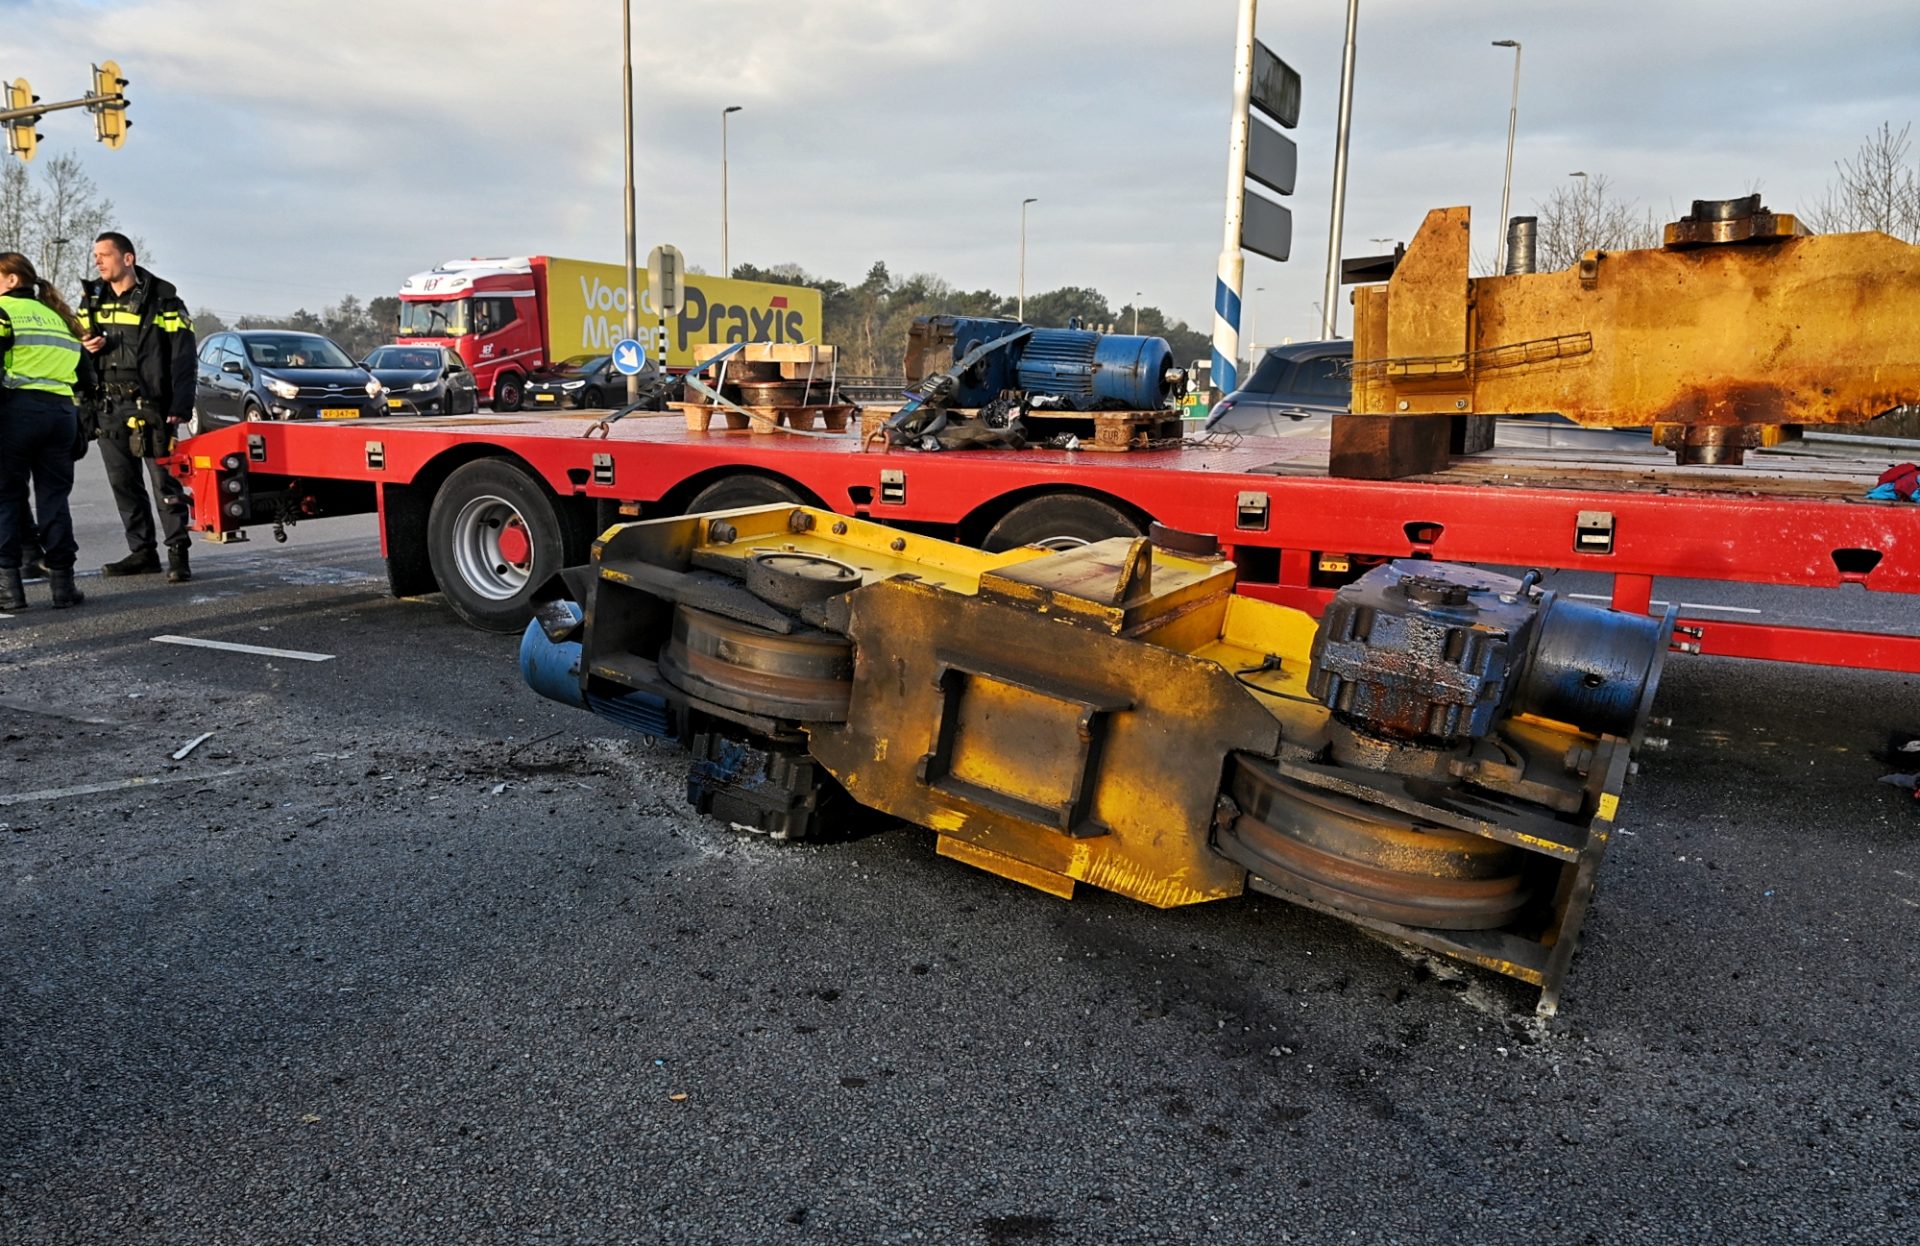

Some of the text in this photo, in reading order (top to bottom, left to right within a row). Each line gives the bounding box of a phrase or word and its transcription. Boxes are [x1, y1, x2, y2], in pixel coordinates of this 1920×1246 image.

[580, 275, 633, 313] Voo
[678, 286, 805, 352] Praxis
[1102, 430, 1119, 440] EUR
